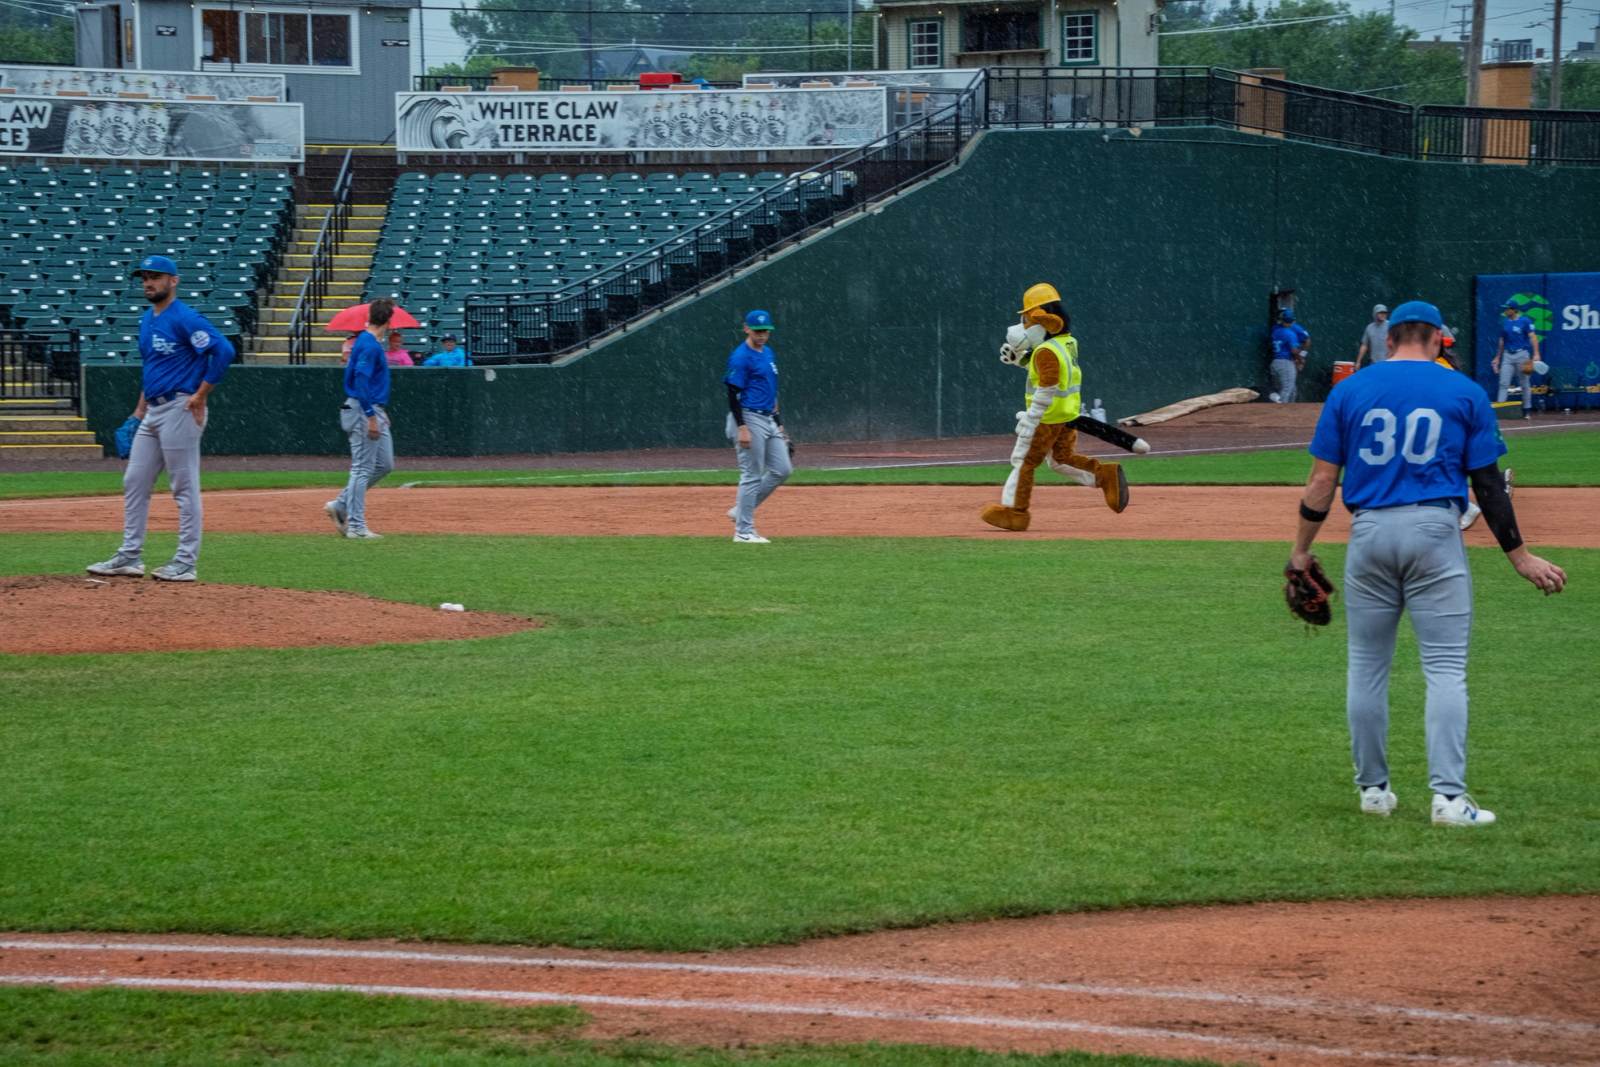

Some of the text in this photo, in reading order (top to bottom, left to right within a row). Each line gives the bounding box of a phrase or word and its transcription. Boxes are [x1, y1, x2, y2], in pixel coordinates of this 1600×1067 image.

[478, 101, 618, 120] WHITE CLAW
[501, 124, 597, 142] TERRACE
[1562, 304, 1600, 330] Sh
[1358, 408, 1442, 465] 30
